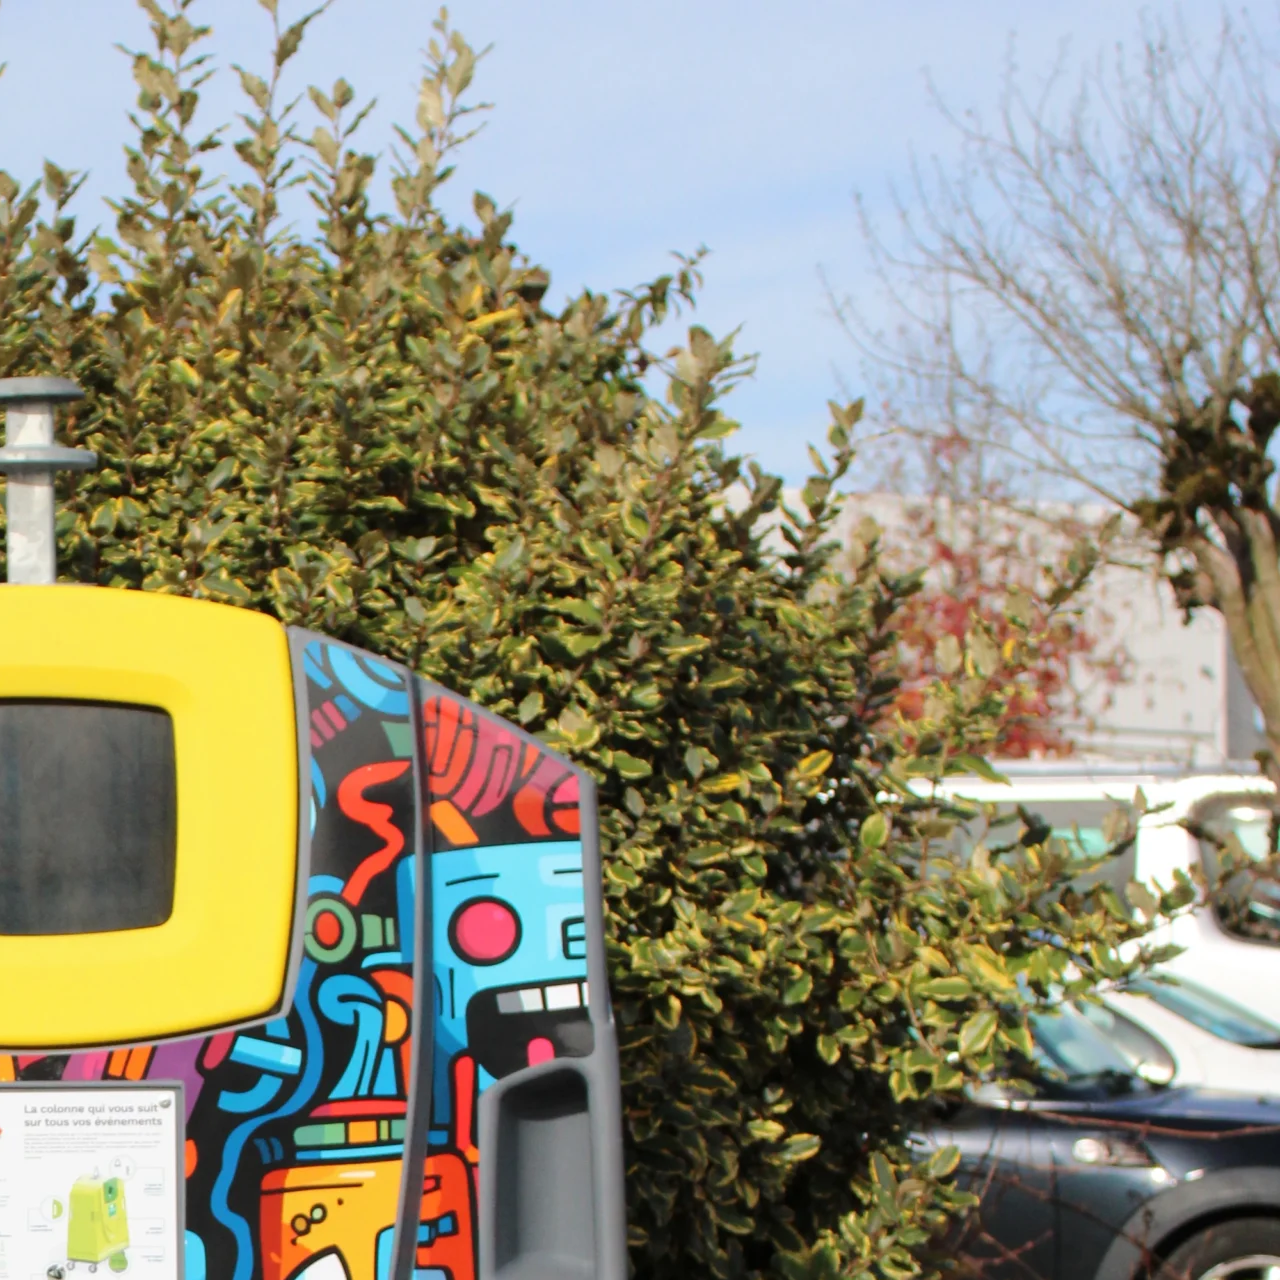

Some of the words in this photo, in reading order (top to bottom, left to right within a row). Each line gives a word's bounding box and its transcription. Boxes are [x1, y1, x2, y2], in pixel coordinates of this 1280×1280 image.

[23, 1104, 38, 1114] La
[40, 1104, 85, 1114] colonne
[87, 1103, 106, 1116] qui
[108, 1105, 135, 1113] vous
[137, 1103, 158, 1113] suit
[23, 1119, 42, 1127] sur
[45, 1117, 70, 1127] tous
[72, 1118, 92, 1127] vos
